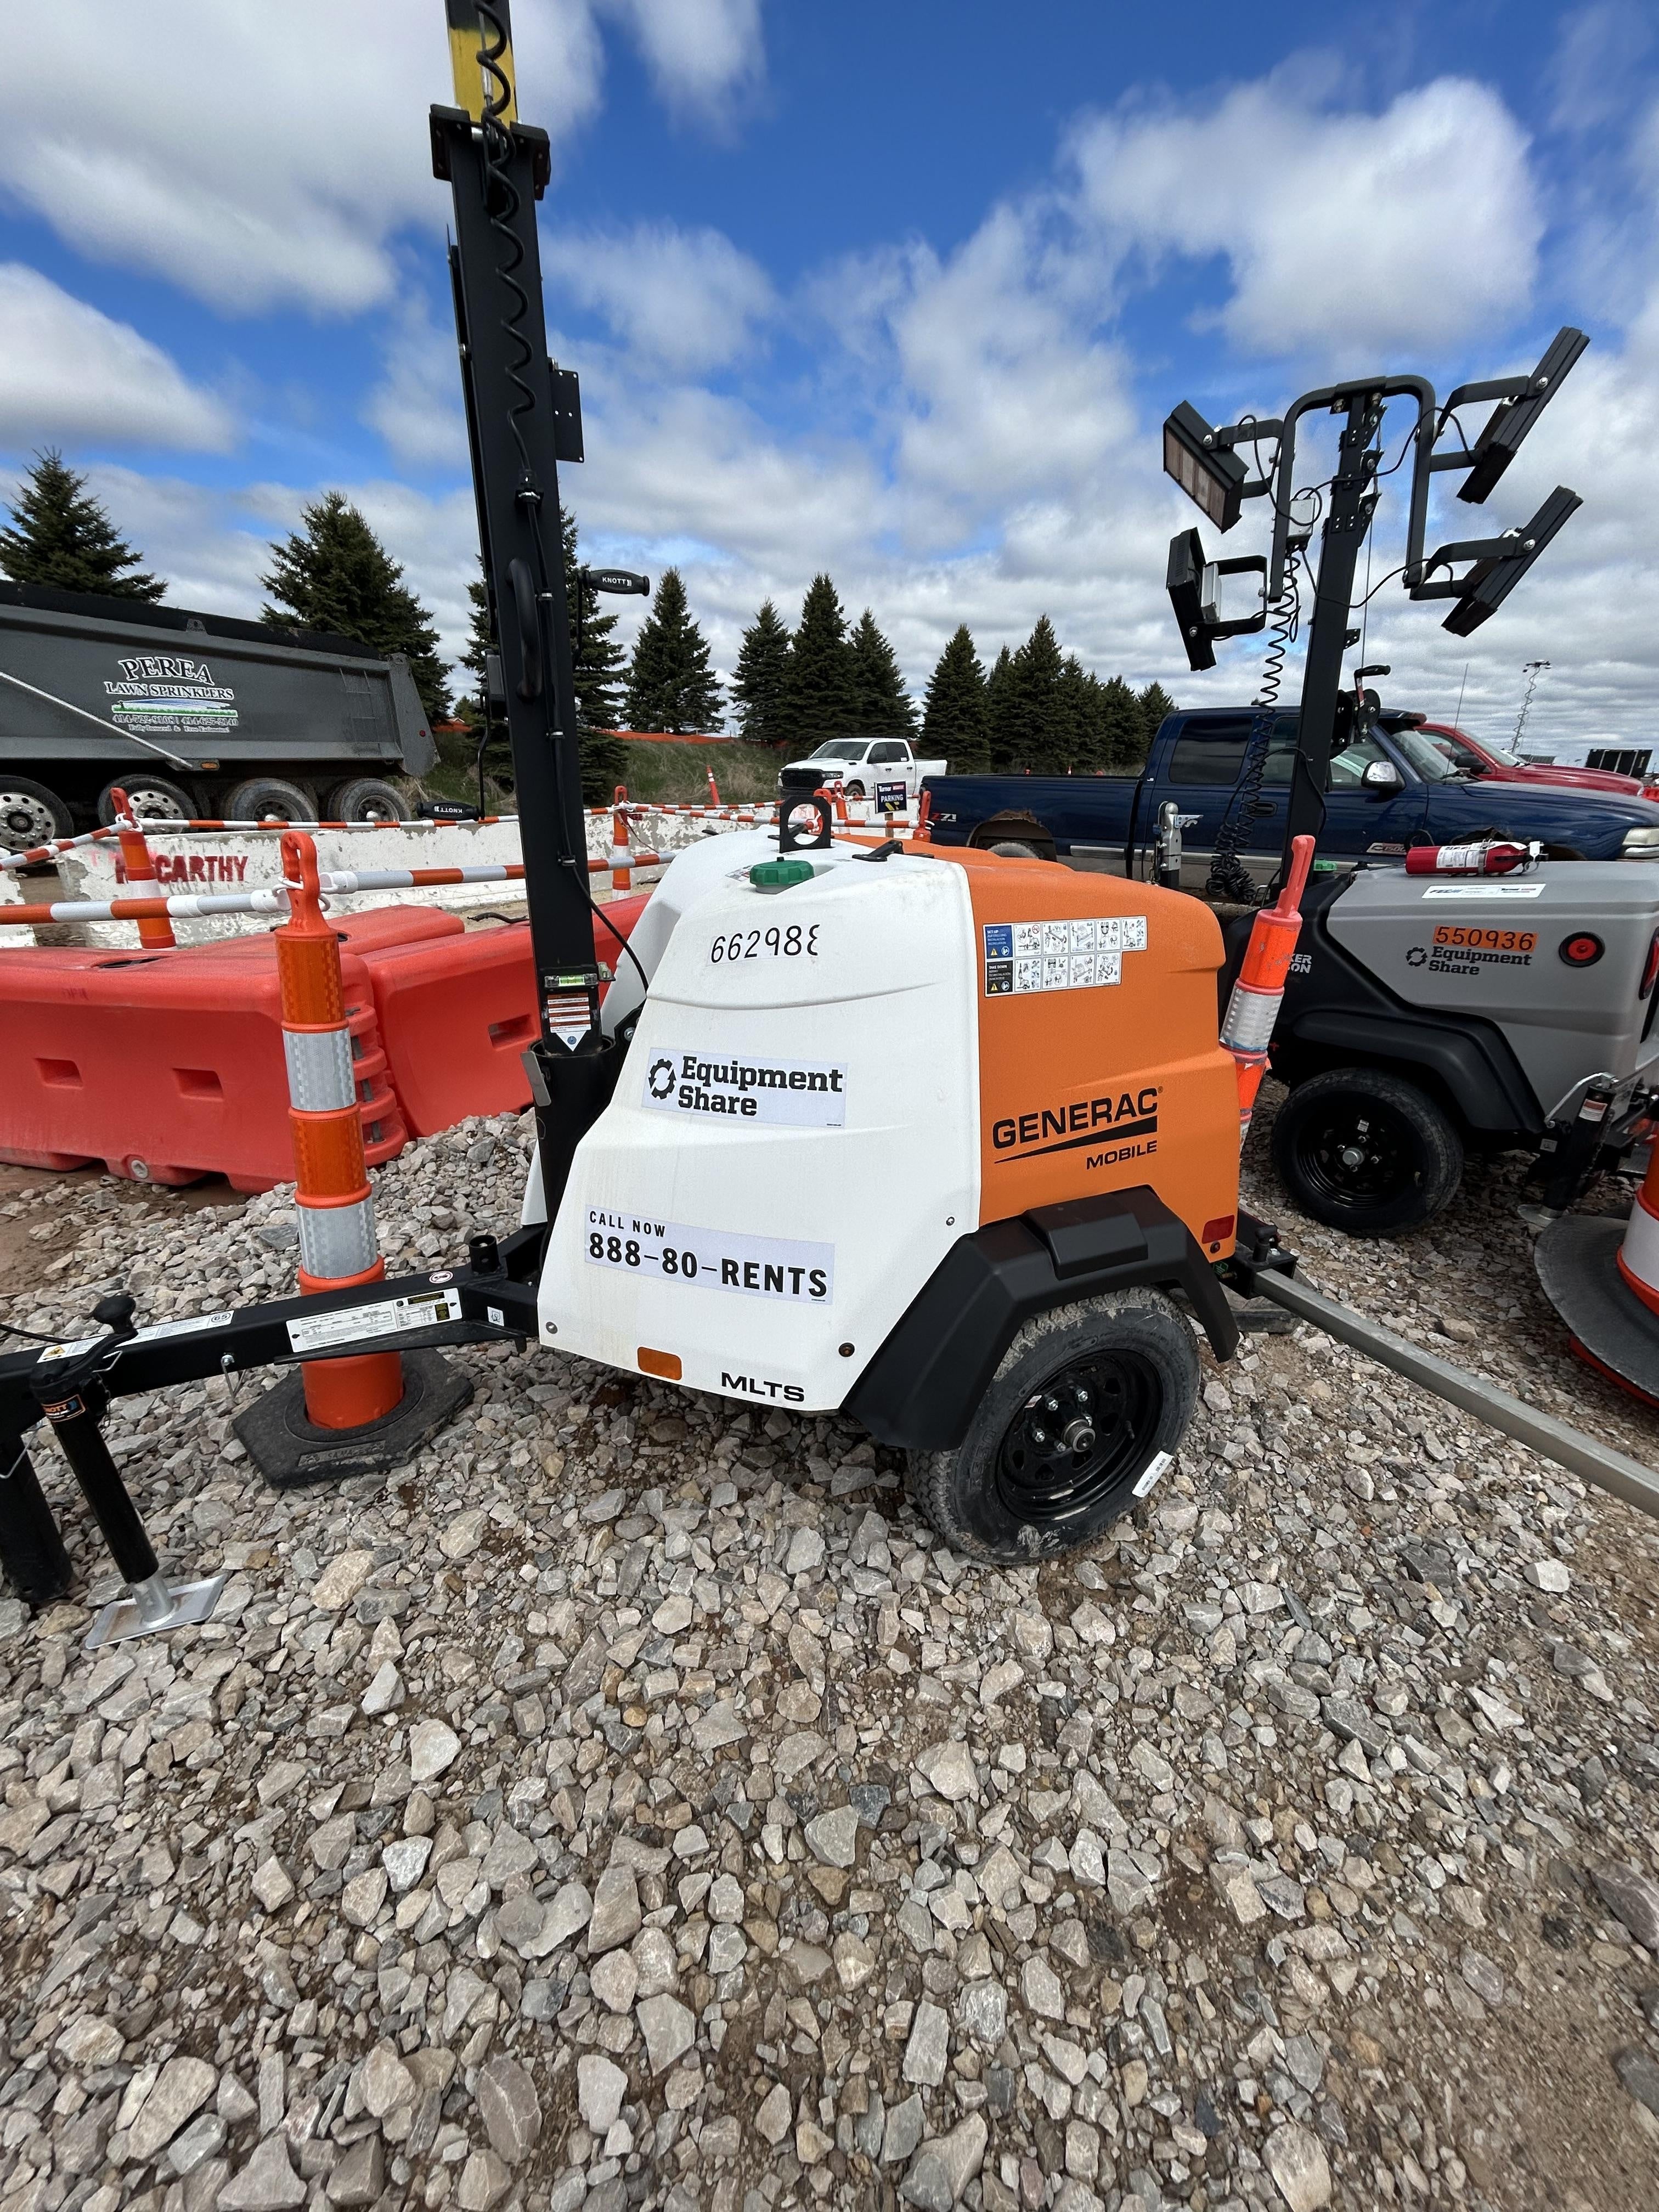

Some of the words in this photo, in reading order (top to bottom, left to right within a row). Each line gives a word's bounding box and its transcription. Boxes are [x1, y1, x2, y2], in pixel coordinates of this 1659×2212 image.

[602, 577, 627, 585] KNOTT
[117, 657, 215, 686] PEREA
[104, 681, 149, 696] LAWN
[149, 684, 234, 700] SPRINKLERS
[881, 794, 904, 803] PARKING
[1435, 926, 1534, 951] 550936
[1429, 960, 1480, 975] Share
[1431, 946, 1532, 966] Equipment
[681, 1056, 843, 1092] Equipment
[678, 1085, 757, 1116] Share
[1086, 1140, 1158, 1170] MOBILE
[589, 1210, 624, 1229] CALL
[633, 1220, 665, 1238] NOW
[589, 1232, 827, 1297] 888-80-RENTS
[721, 1372, 805, 1402] MLTS
